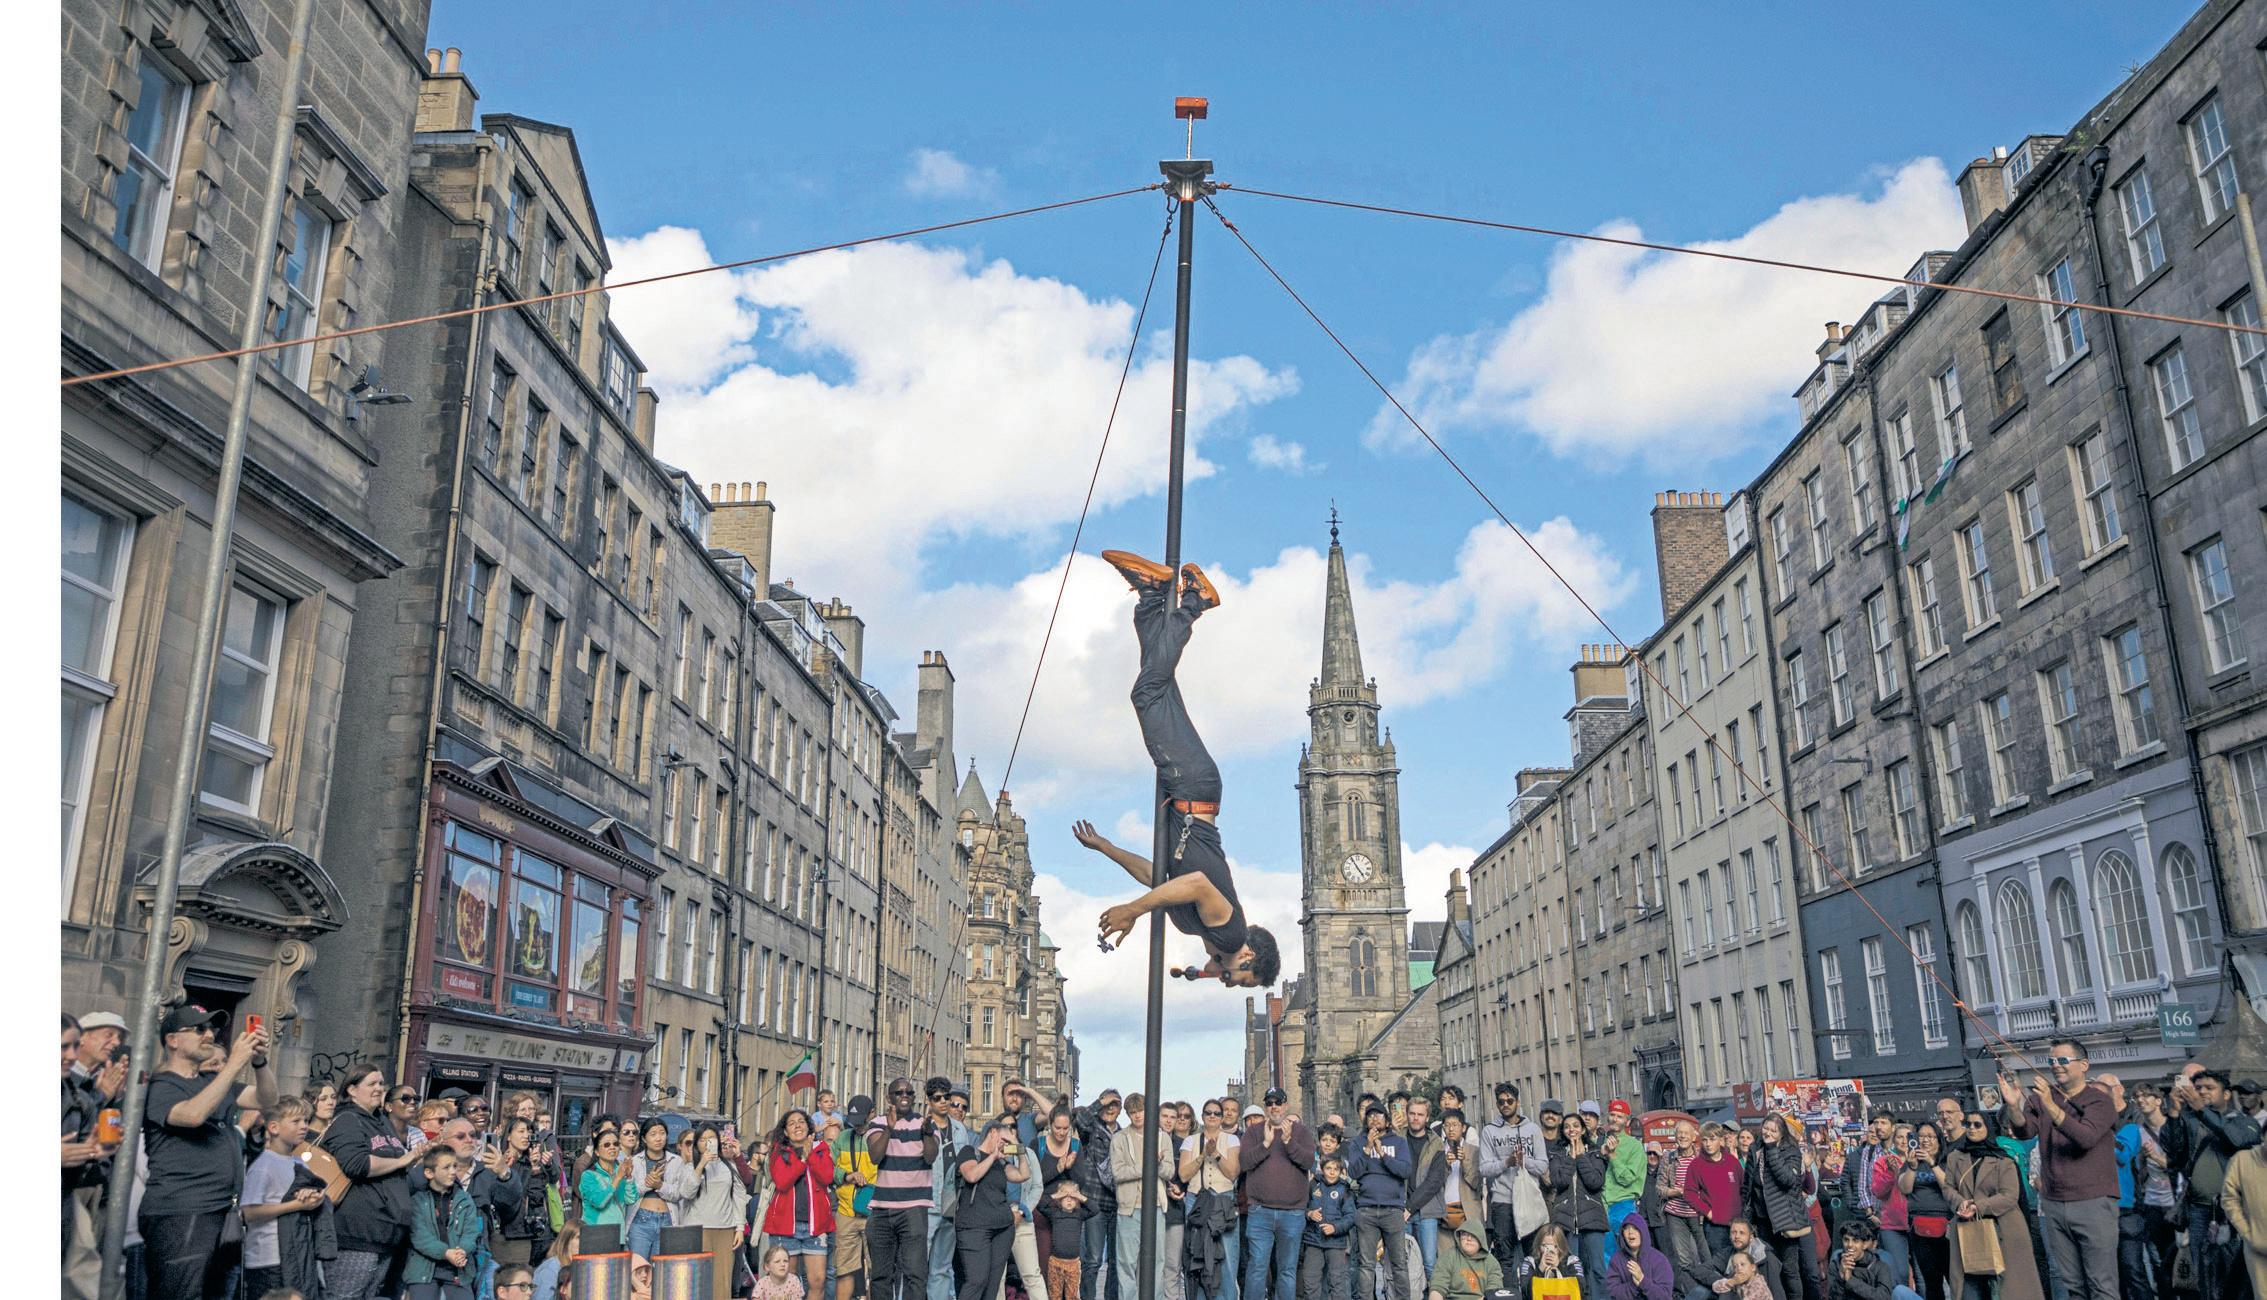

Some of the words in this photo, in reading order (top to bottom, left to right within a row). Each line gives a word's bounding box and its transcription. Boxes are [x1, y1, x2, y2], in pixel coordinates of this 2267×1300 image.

[2163, 1010, 2193, 1027] 166
[464, 1034, 490, 1053] THE
[498, 1039, 546, 1060] FILLING
[553, 1047, 594, 1065] STATION
[2109, 1046, 2140, 1058] OUTLET
[442, 1068, 460, 1077] FILLING
[461, 1069, 479, 1078] STATION
[1493, 1133, 1534, 1147] twisted
